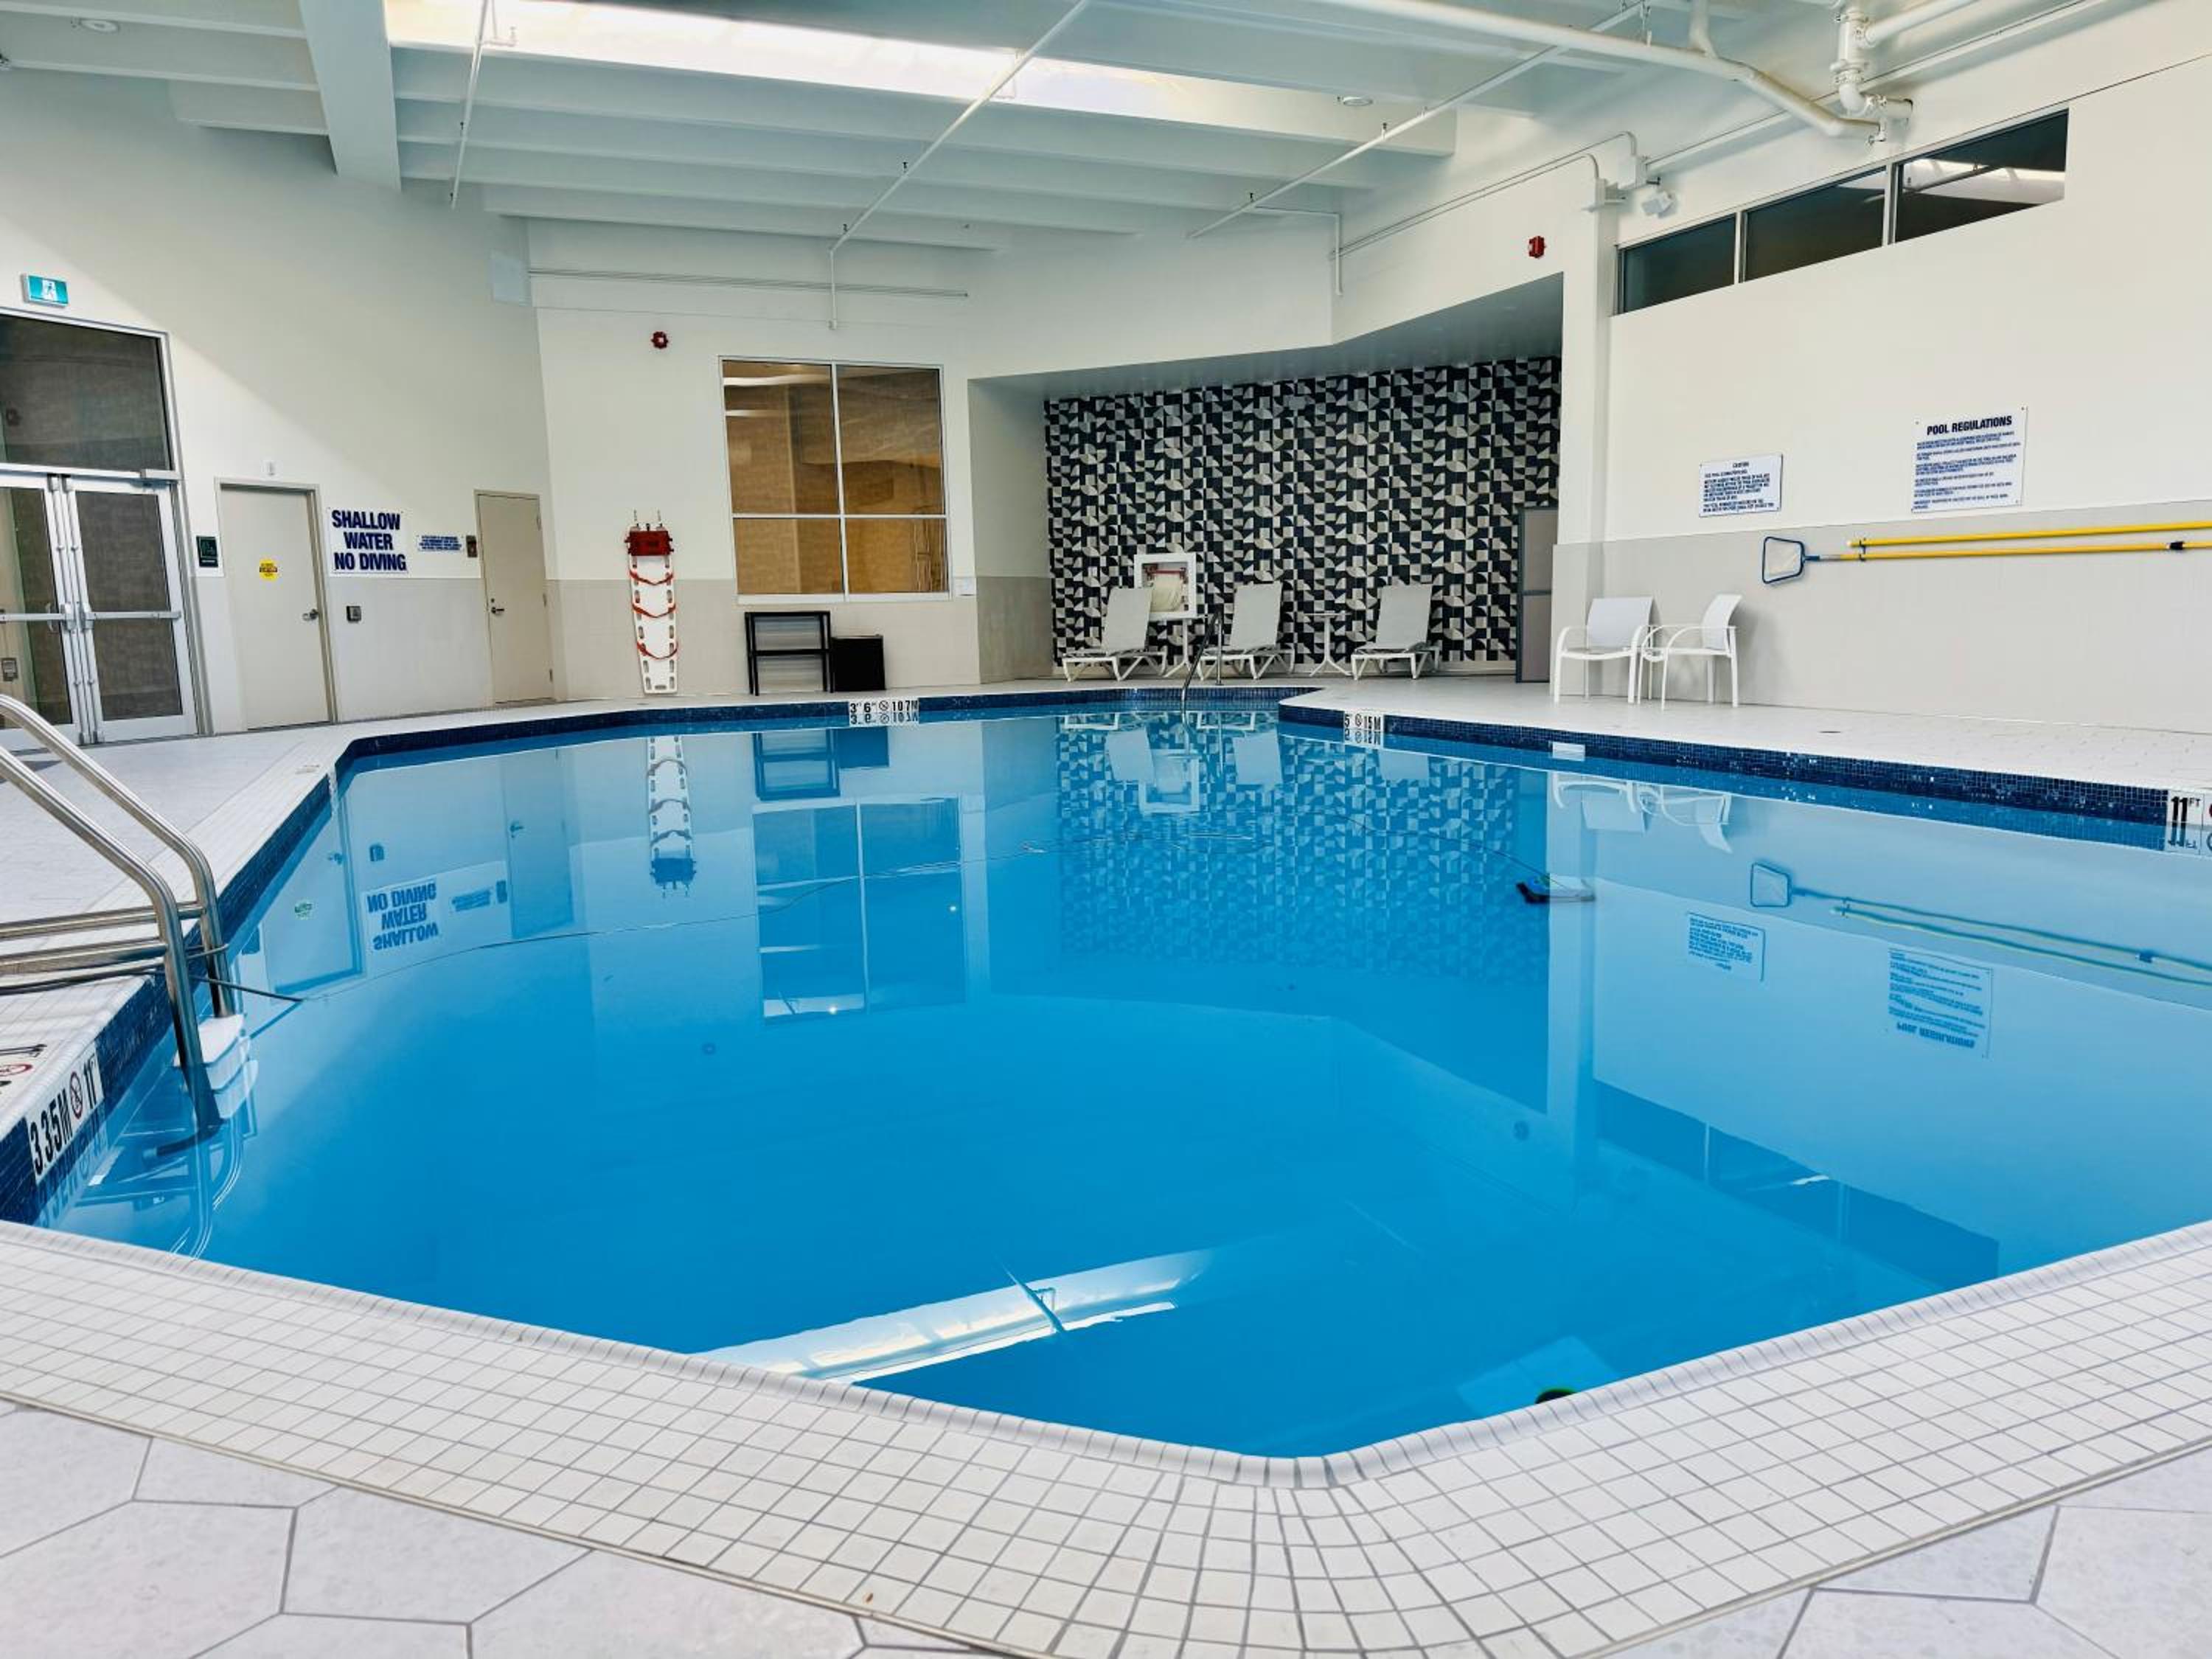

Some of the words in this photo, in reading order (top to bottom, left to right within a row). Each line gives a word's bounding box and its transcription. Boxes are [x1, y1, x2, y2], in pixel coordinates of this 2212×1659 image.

[1927, 424, 1950, 436] POOL
[1952, 415, 2012, 433] REGULATIONS
[332, 509, 400, 530] SHALLOW
[344, 532, 394, 550] WATER
[335, 552, 355, 570] NO
[359, 553, 407, 571] DIVING
